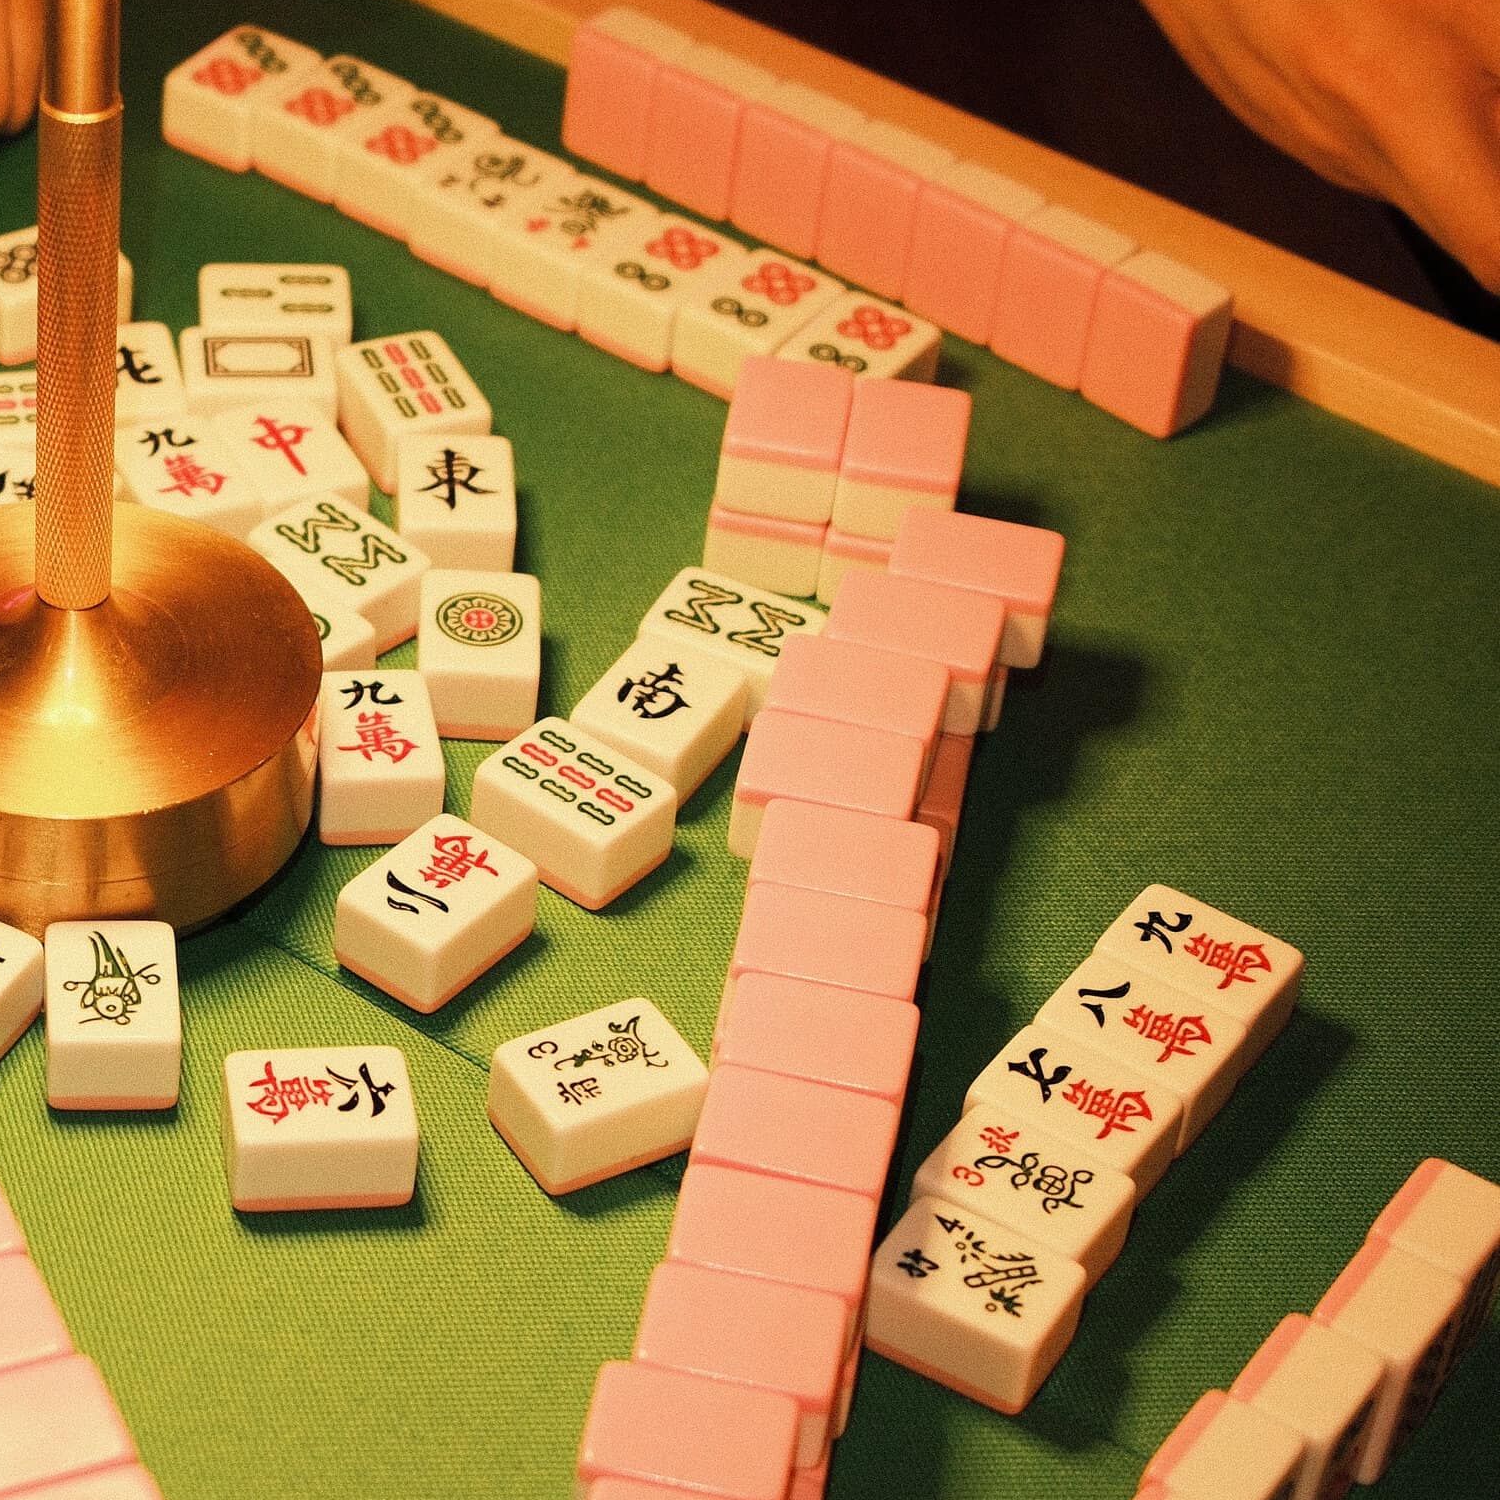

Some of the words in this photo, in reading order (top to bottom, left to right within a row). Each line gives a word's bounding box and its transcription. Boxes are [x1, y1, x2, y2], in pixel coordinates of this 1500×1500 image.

[140, 429, 225, 496] 九萬
[253, 417, 308, 475] 中
[422, 449, 492, 509] 東
[338, 681, 417, 763] 九萬
[618, 664, 690, 719] 南
[386, 833, 499, 915] 二萬
[1135, 910, 1272, 990] 九萬
[528, 1041, 558, 1059] 3
[1078, 982, 1211, 1062] 八萬
[247, 1062, 395, 1124] 六萬
[1008, 1047, 1152, 1140] 七萬
[953, 1165, 985, 1187] 3
[935, 1213, 964, 1234] 4
